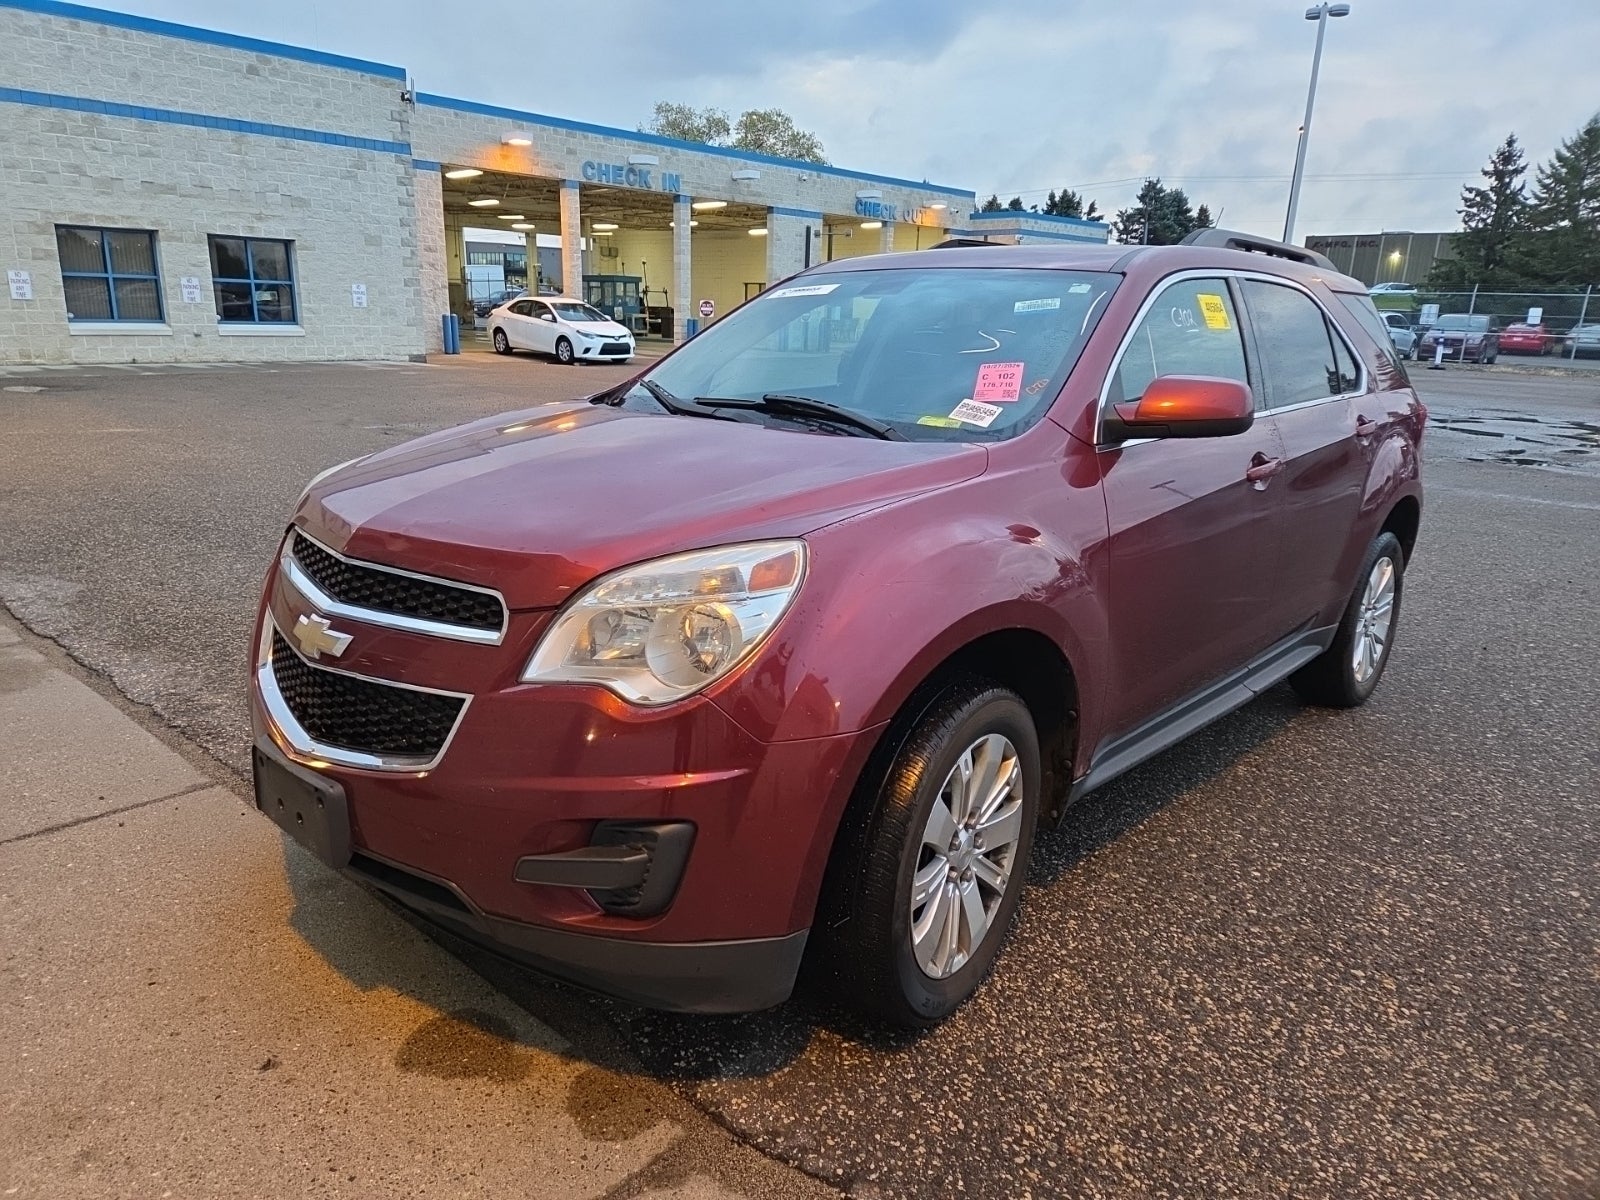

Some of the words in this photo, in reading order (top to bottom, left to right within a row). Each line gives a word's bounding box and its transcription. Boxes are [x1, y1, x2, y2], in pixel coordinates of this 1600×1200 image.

[582, 161, 651, 188] CHECK
[661, 172, 680, 192] IN
[855, 200, 897, 220] CHECK
[903, 208, 926, 224] OUT
